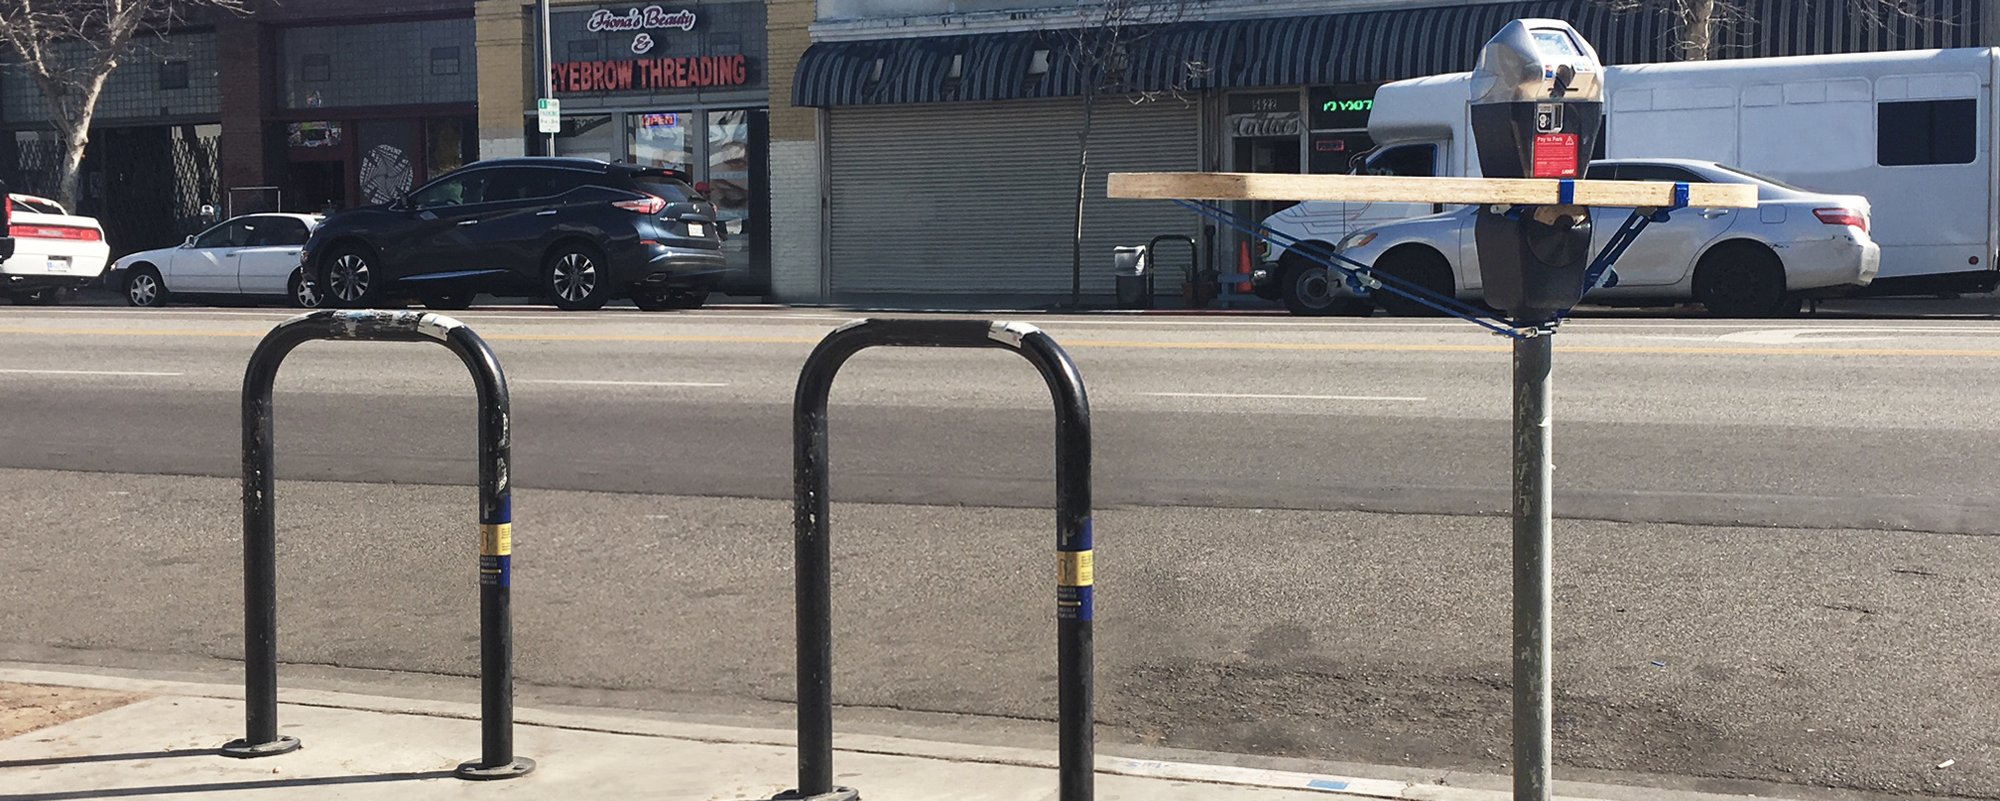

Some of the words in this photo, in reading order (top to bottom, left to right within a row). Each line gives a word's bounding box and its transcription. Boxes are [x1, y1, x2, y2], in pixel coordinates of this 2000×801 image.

[644, 5, 696, 31] Beauty
[631, 33, 654, 53] &
[638, 55, 745, 87] THREADING
[641, 115, 673, 126] OPEN
